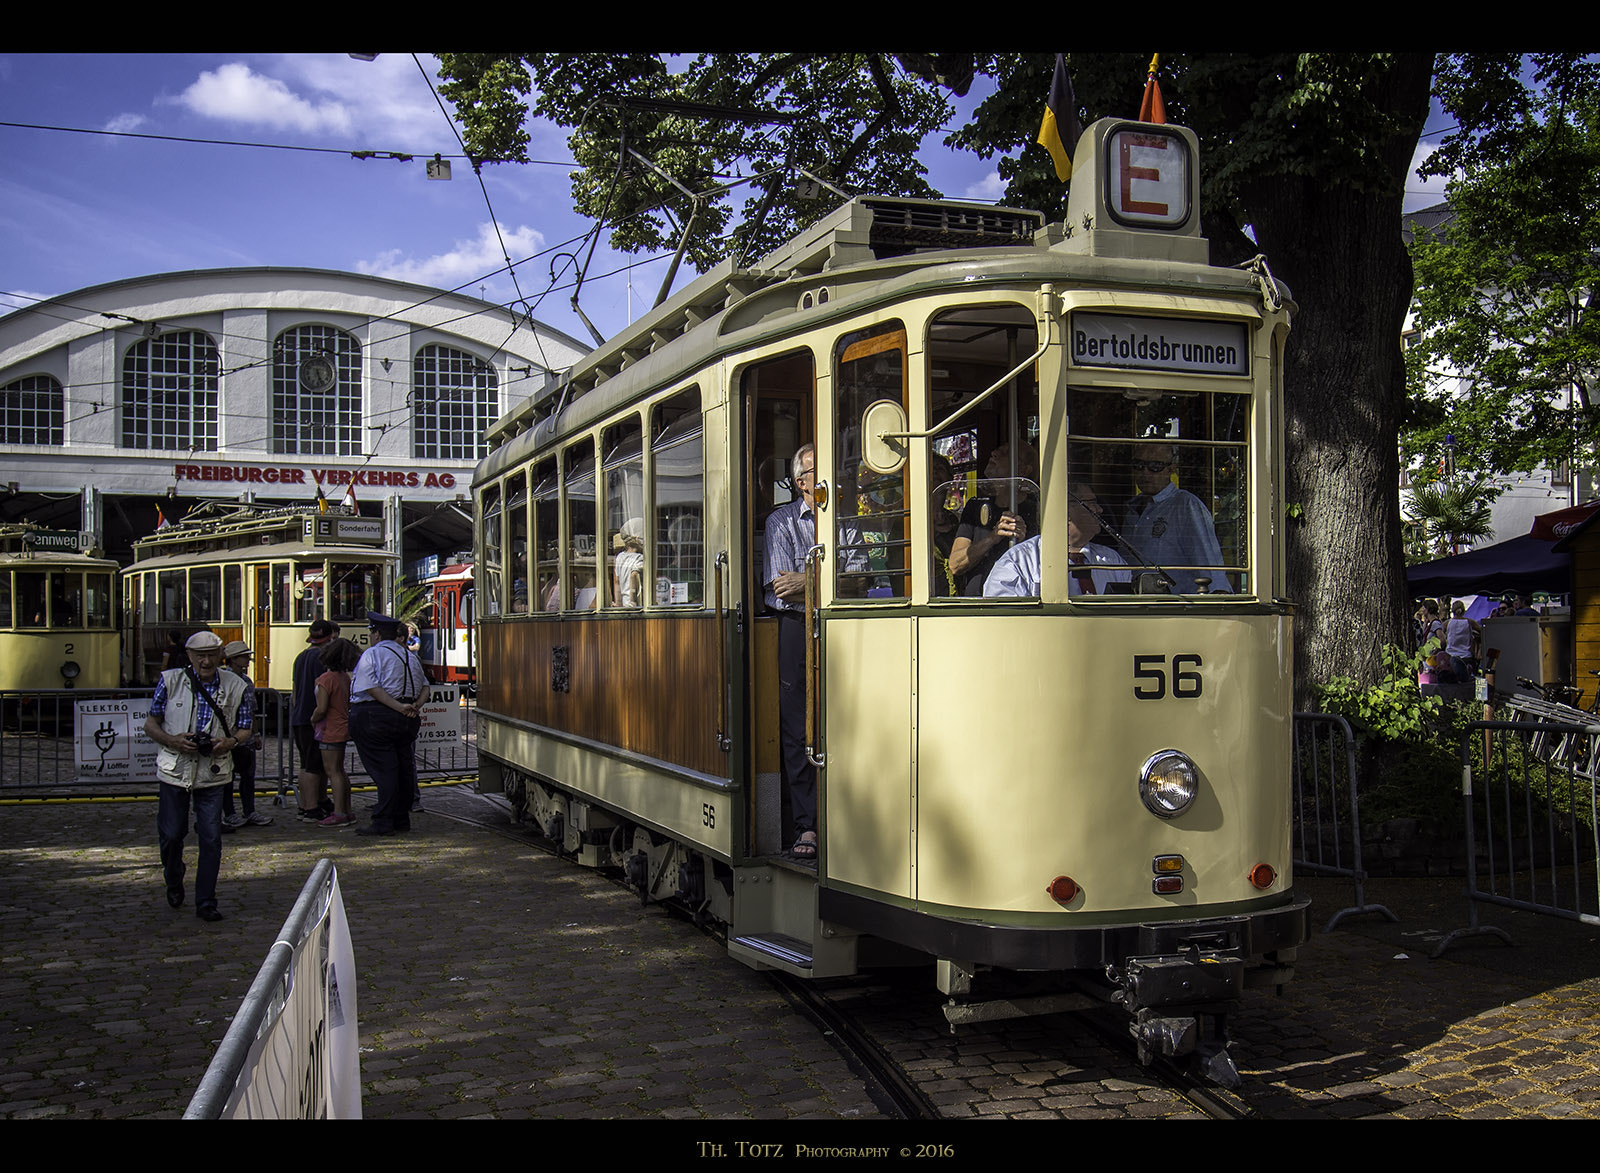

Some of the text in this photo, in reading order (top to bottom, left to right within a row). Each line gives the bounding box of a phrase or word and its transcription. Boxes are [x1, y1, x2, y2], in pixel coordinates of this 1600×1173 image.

[1120, 133, 1168, 216] E
[1075, 329, 1237, 365] Bertoldsbrunnen
[174, 464, 456, 488] FREIBURGER VERKEHRS AG
[320, 522, 381, 533] E Sonderfahrt
[35, 535, 78, 549] ennweg
[64, 643, 74, 655] 2
[351, 633, 369, 646] 45
[1133, 654, 1203, 700] 56
[80, 704, 129, 713] ELEKTRO
[703, 803, 716, 829] 56
